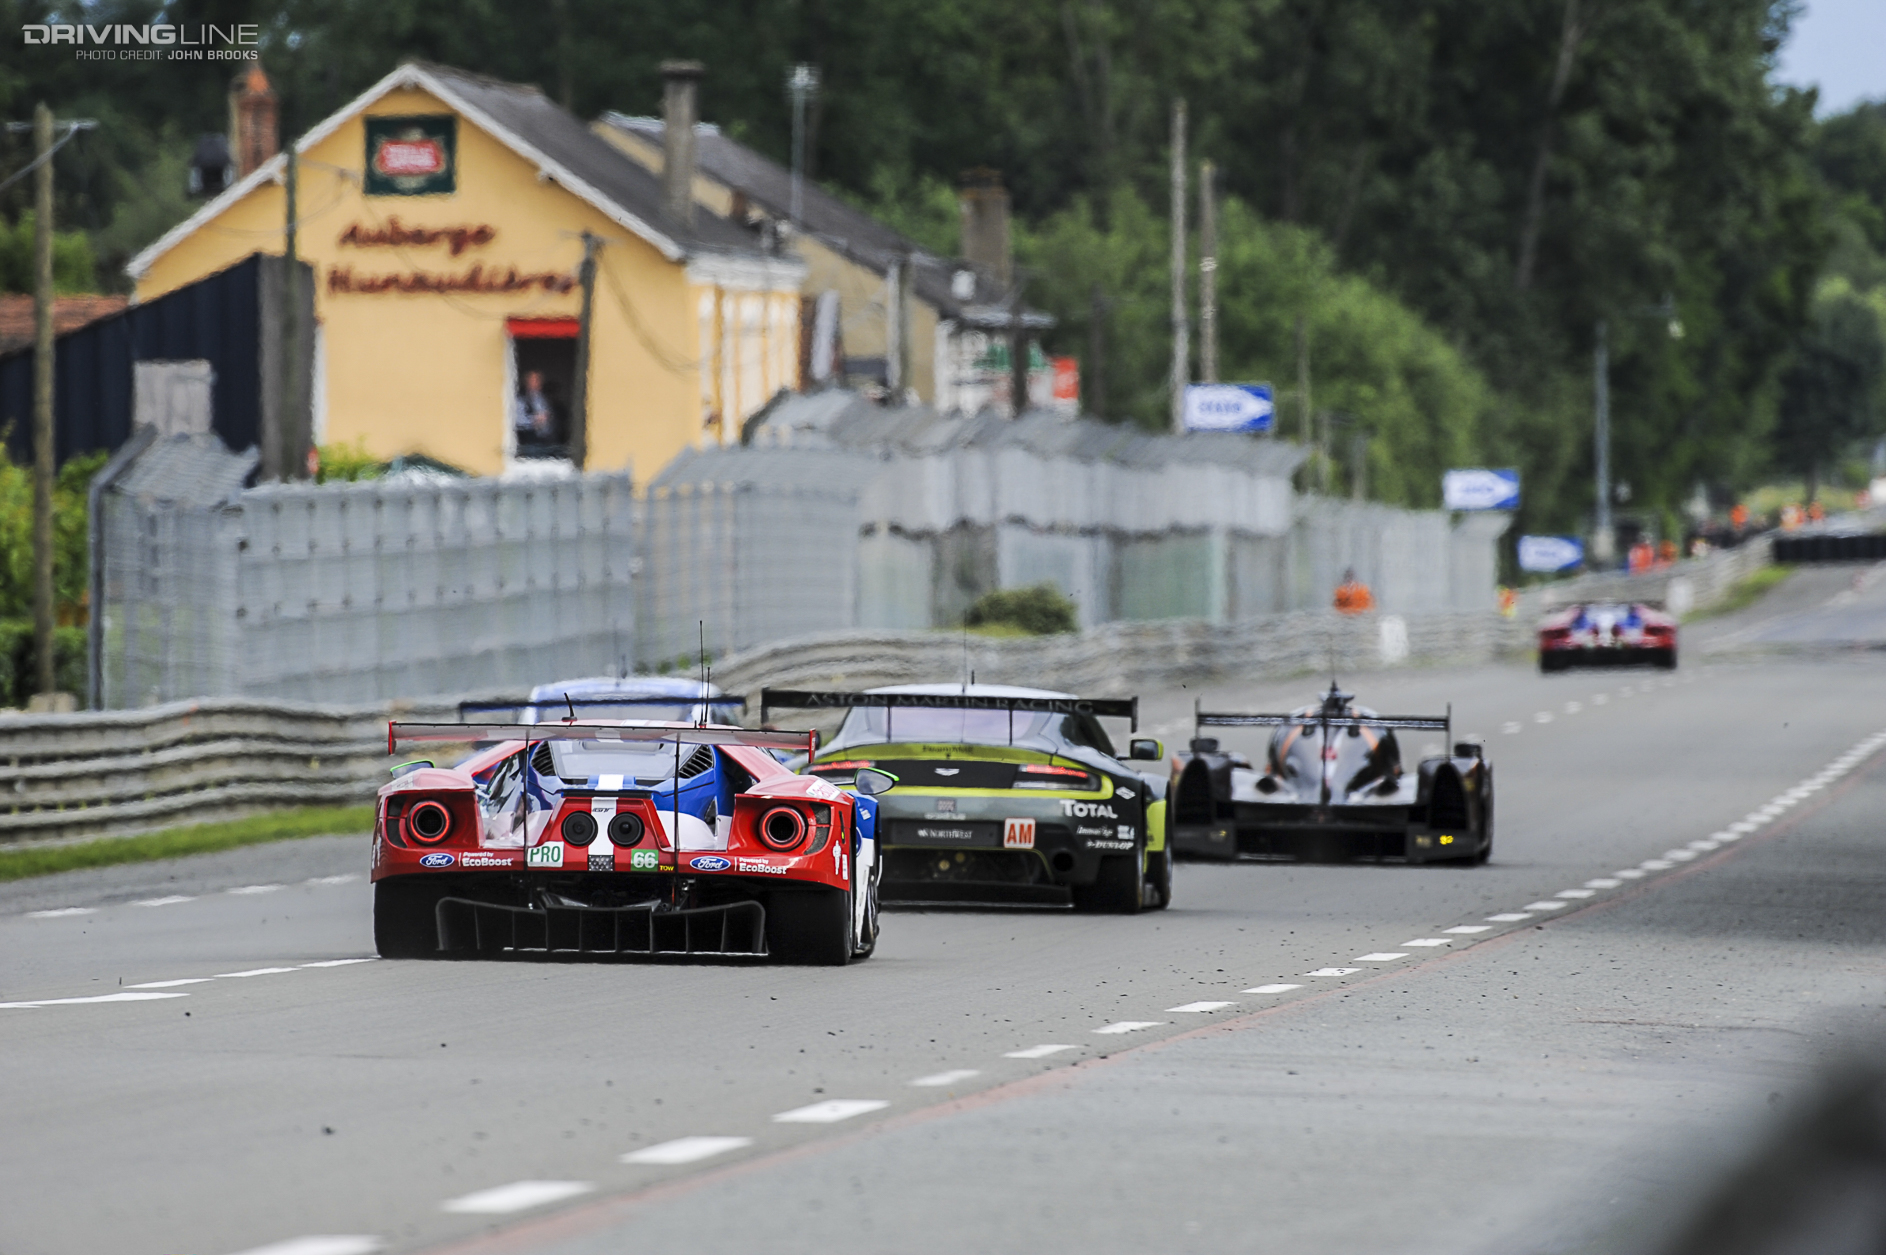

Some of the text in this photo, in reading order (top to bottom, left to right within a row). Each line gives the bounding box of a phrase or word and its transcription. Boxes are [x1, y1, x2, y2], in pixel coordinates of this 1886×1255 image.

[338, 215, 497, 257] Auberge
[806, 693, 1094, 713] ASTON MARTIN RACING
[1060, 799, 1118, 819] TOTAL
[1006, 823, 1033, 844] AM
[529, 845, 561, 863] PRO
[1094, 840, 1135, 850] DUNLOP
[462, 857, 512, 867] EcoBoost
[633, 851, 656, 869] 66
[739, 863, 787, 874] EcoBoost
